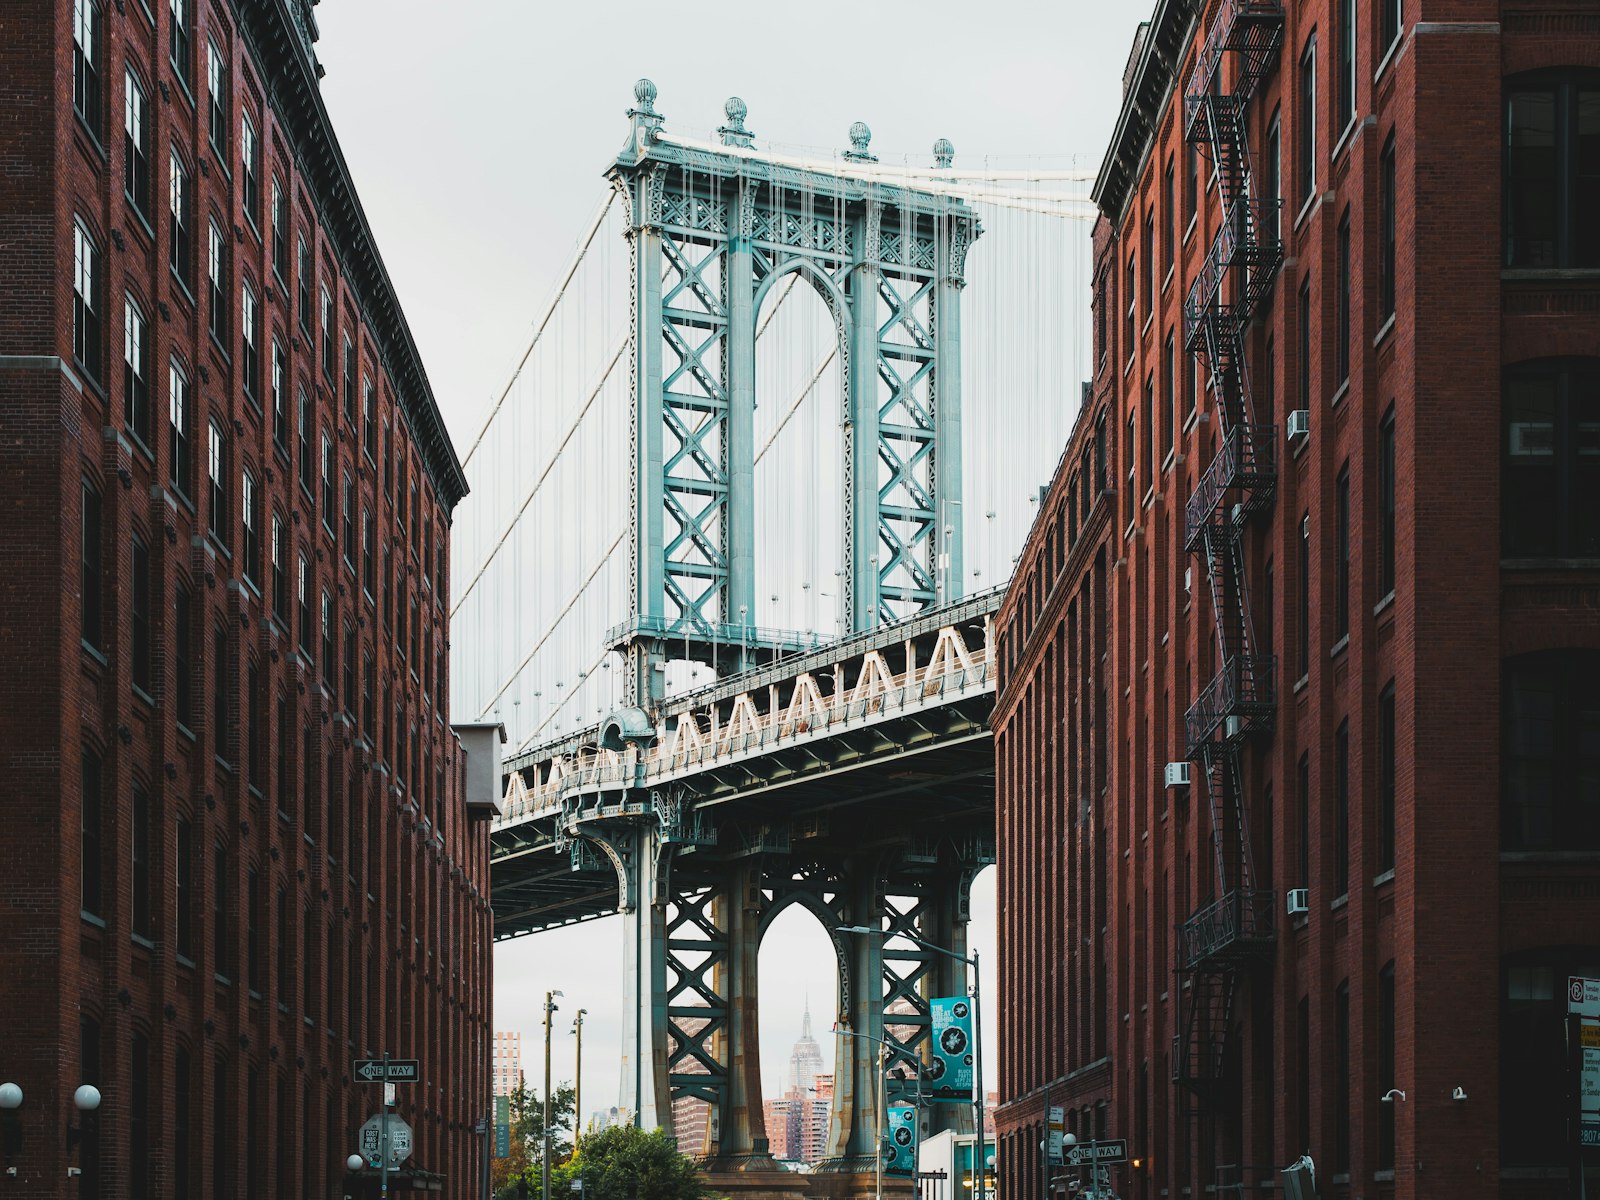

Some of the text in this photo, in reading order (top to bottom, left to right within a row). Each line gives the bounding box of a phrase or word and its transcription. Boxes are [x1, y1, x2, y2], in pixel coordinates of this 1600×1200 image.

[932, 1010, 951, 1018] GREAT
[364, 1066, 410, 1075] ONE WAY
[1072, 1146, 1118, 1158] ONE WAY
[974, 1192, 995, 1200] PRK
